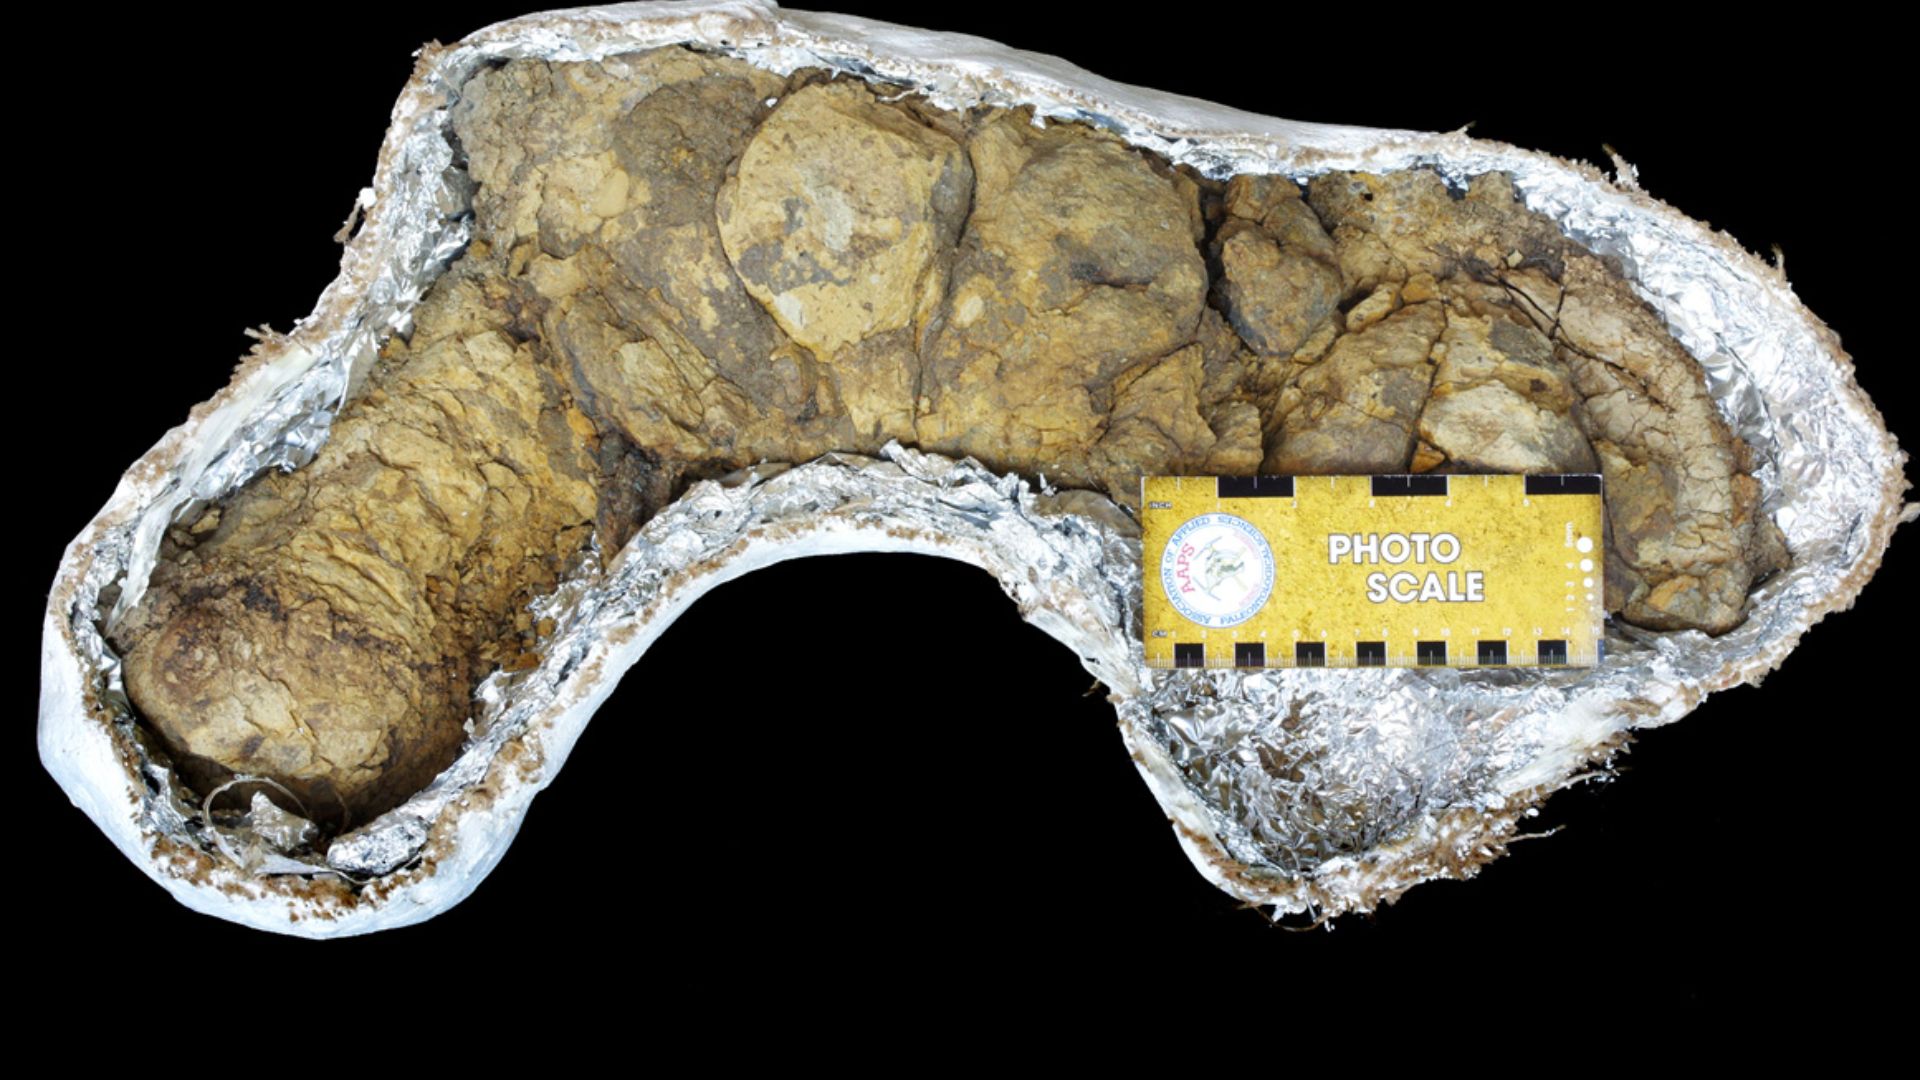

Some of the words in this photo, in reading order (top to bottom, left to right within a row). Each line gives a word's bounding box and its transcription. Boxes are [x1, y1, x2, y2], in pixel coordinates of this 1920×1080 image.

[1172, 517, 1210, 546] APPLIED
[1218, 516, 1265, 546] SCIENCES
[1164, 549, 1174, 563] OF
[1328, 533, 1462, 565] PHOTO
[1177, 543, 1195, 593] AAPS
[1163, 567, 1211, 624] ASSOCIATION
[1366, 571, 1485, 603] SCALE
